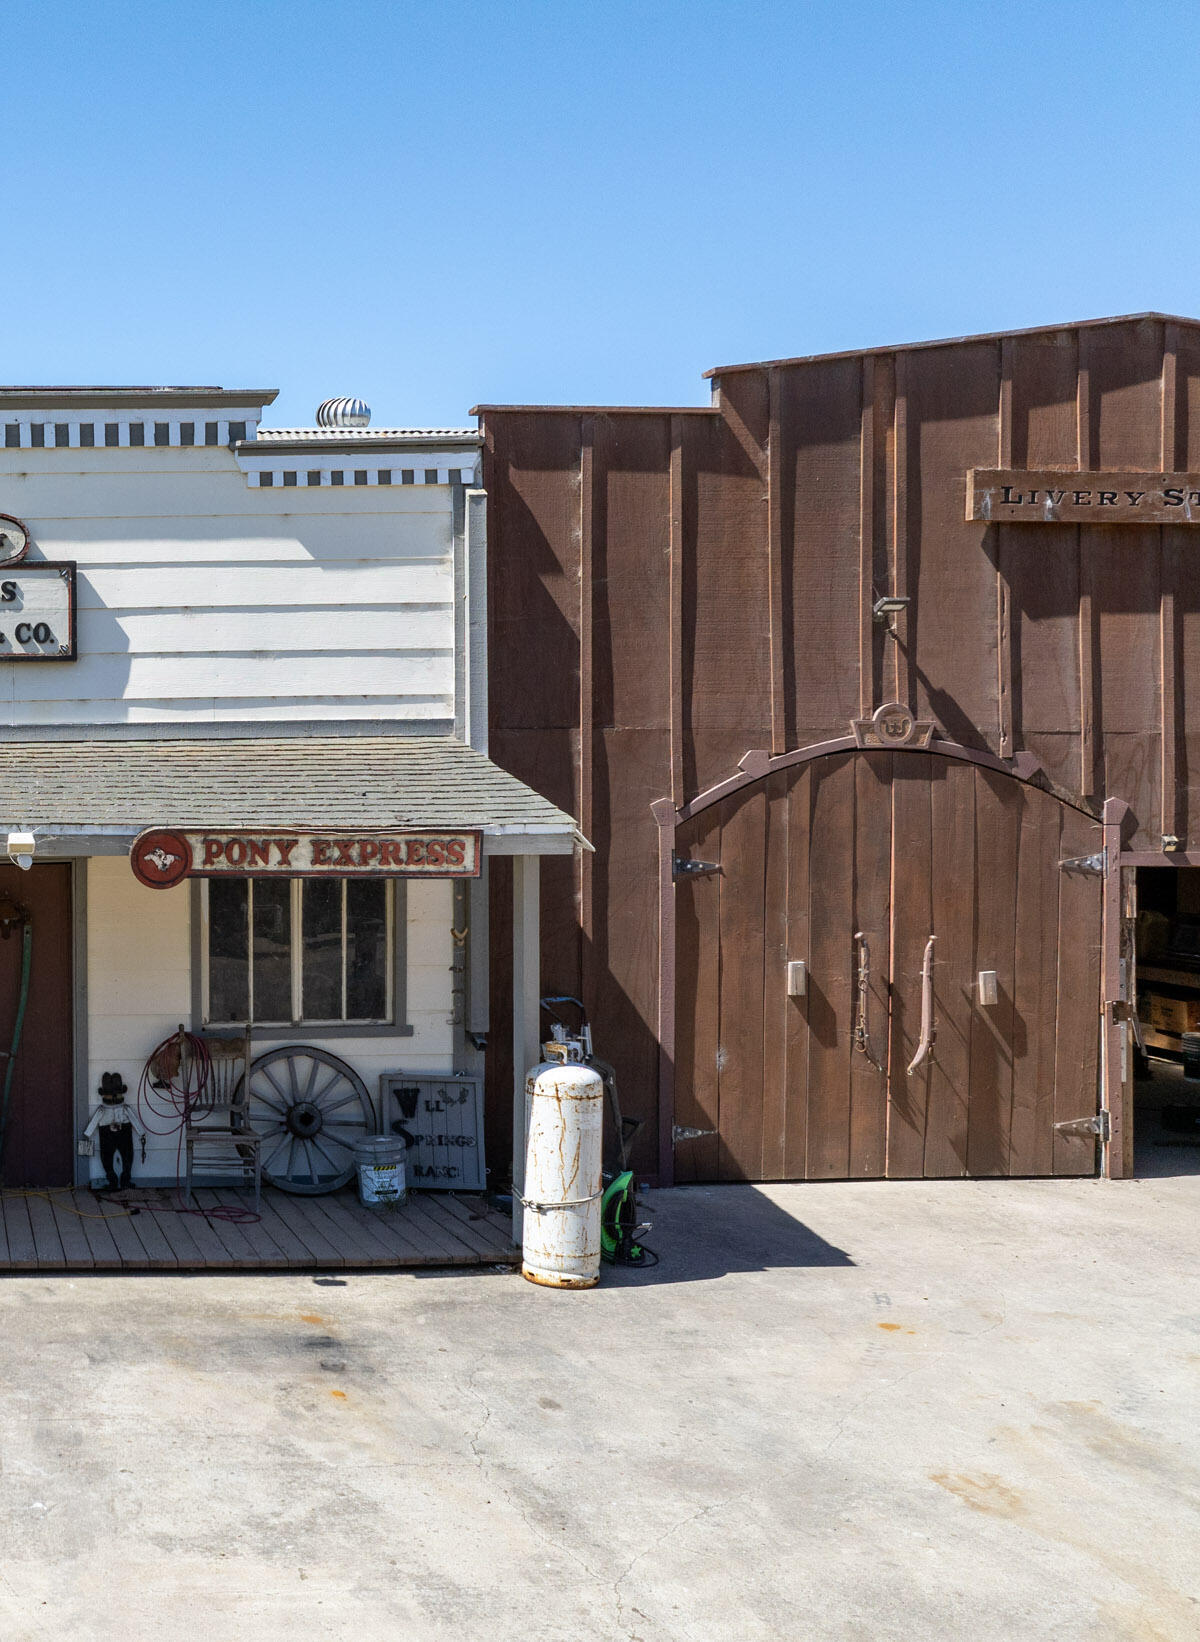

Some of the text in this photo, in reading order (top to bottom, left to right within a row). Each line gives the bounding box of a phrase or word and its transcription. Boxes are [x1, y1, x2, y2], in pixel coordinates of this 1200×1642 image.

[1000, 486, 1145, 506] LIVERY
[15, 622, 55, 645] CO.
[202, 839, 466, 866] PONY EXPRESS
[413, 1164, 460, 1178] RANC
